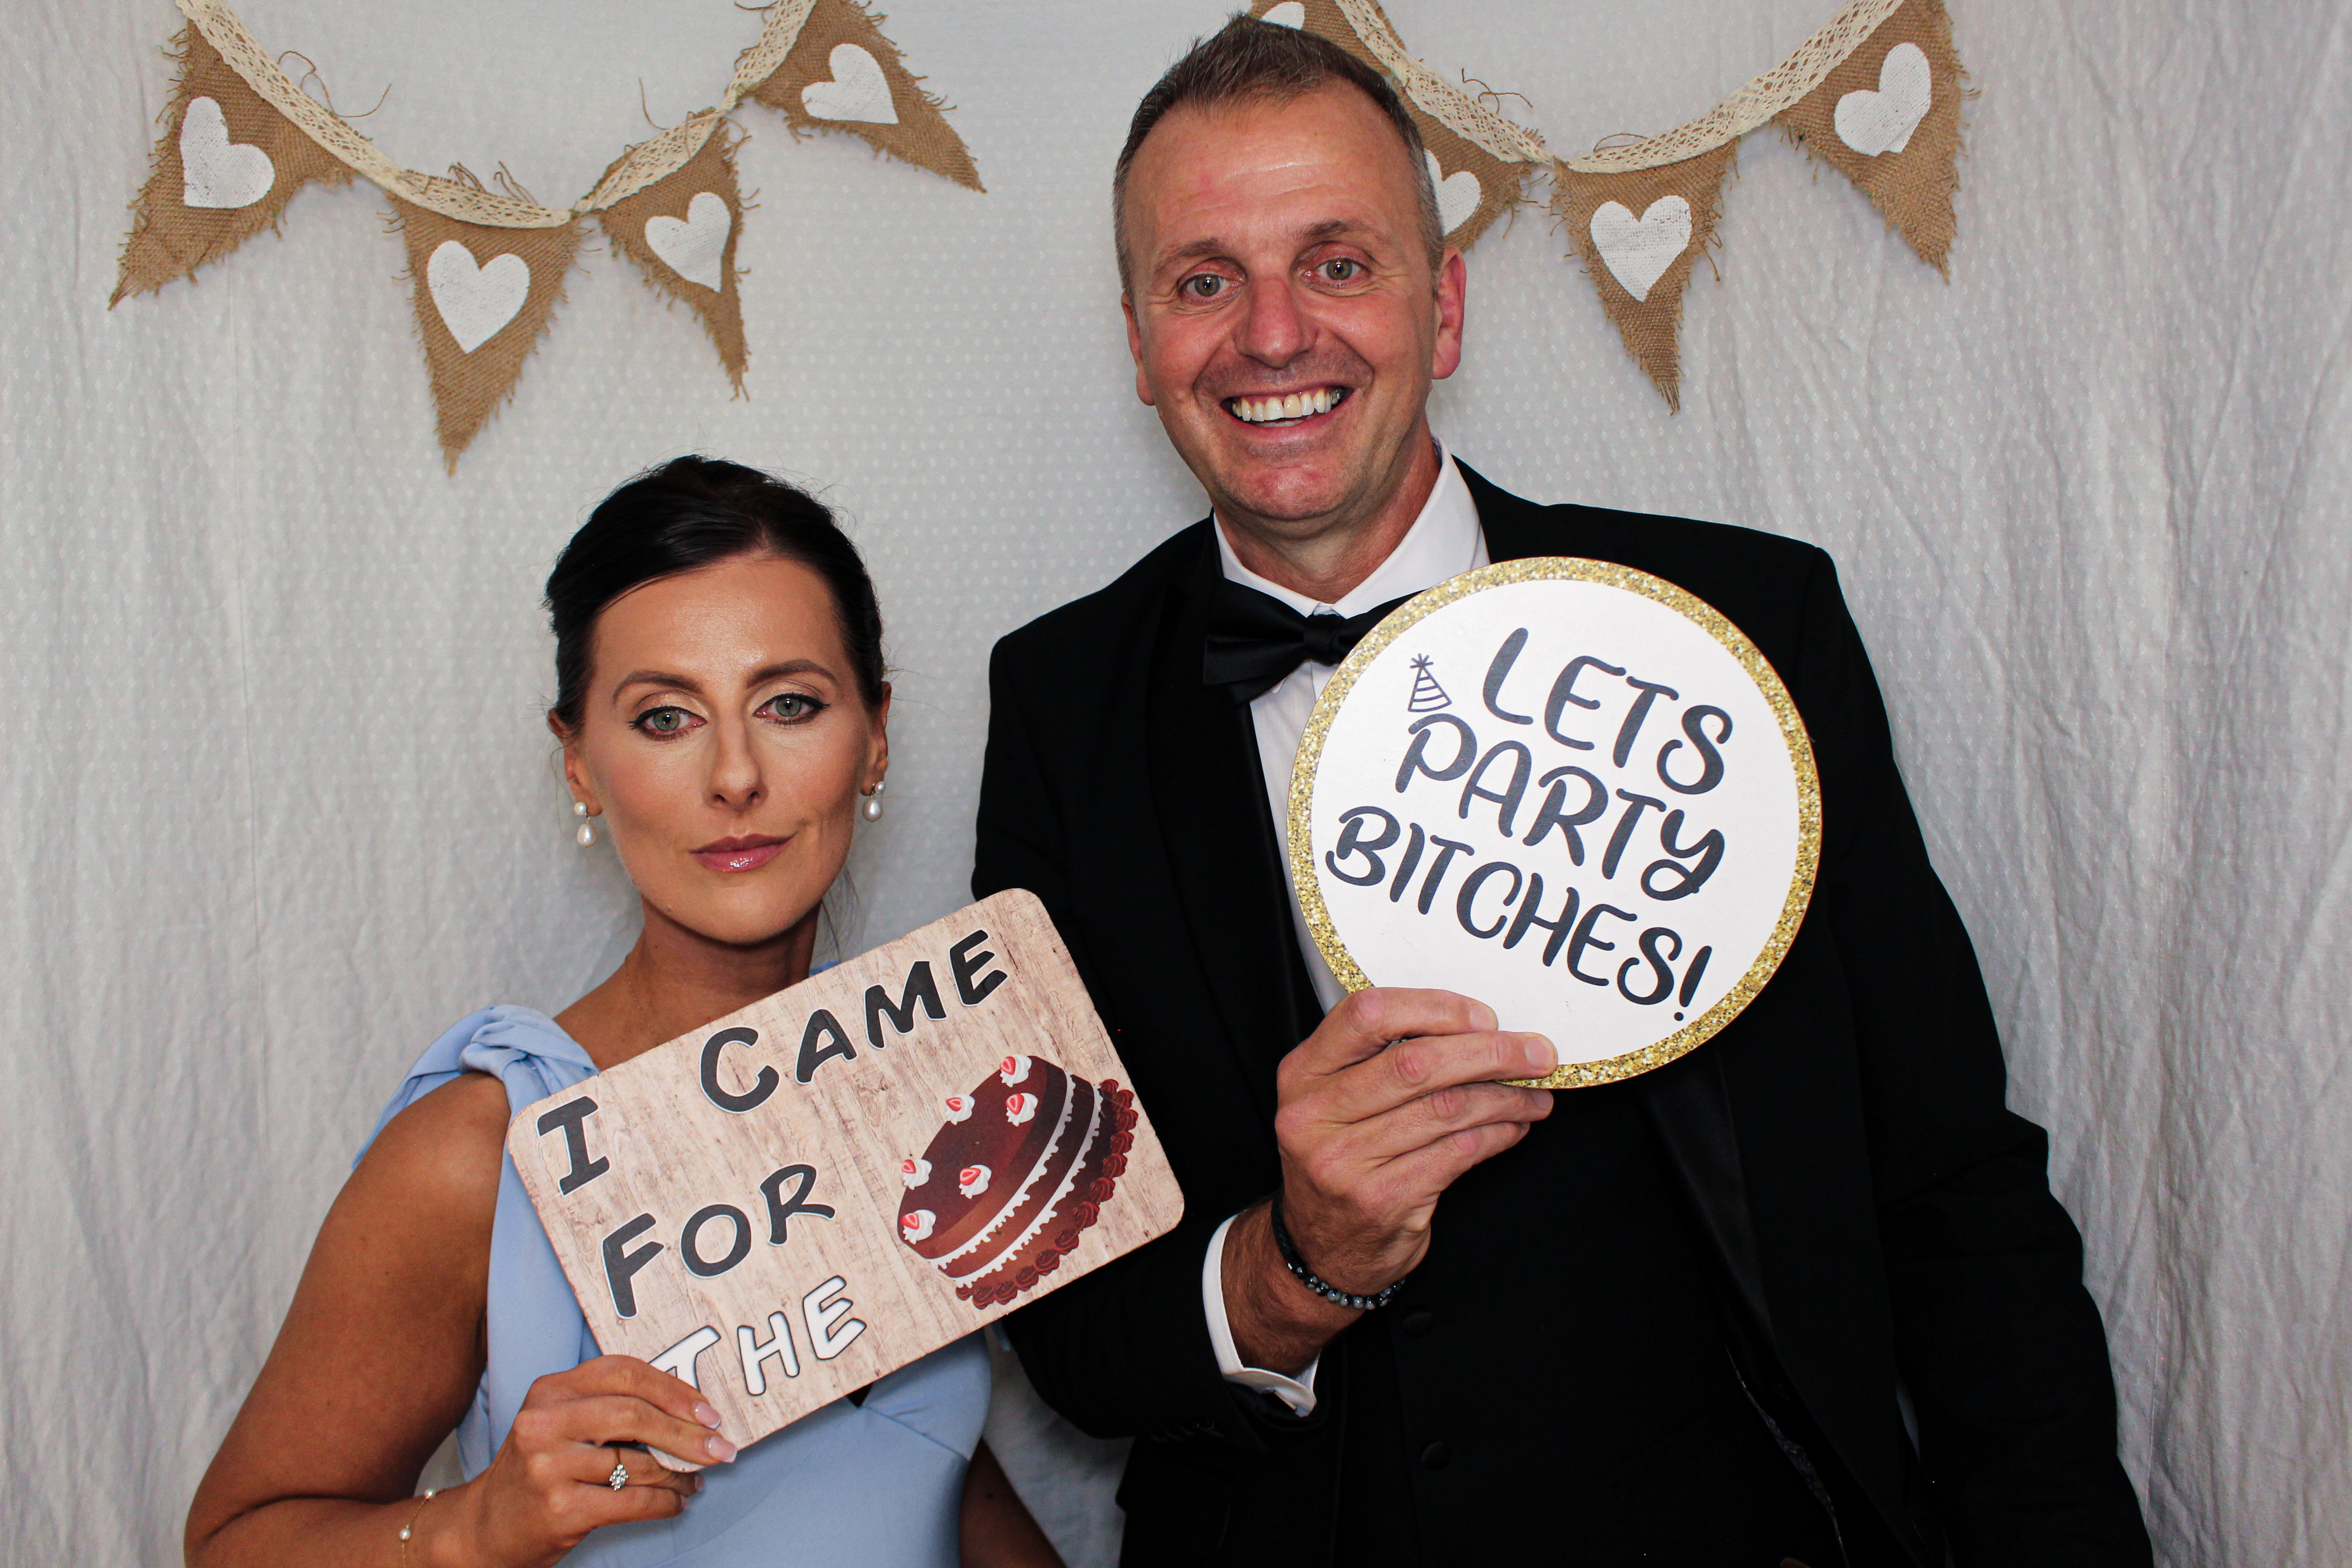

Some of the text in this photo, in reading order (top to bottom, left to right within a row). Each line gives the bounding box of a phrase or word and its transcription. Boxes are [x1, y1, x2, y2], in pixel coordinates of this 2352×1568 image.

[1482, 627, 1733, 795] LETS
[1395, 713, 1725, 902] PARTY
[1324, 805, 1713, 1022] BITCHES!
[536, 928, 1008, 1197] I CAME
[601, 1163, 836, 1319] FOR
